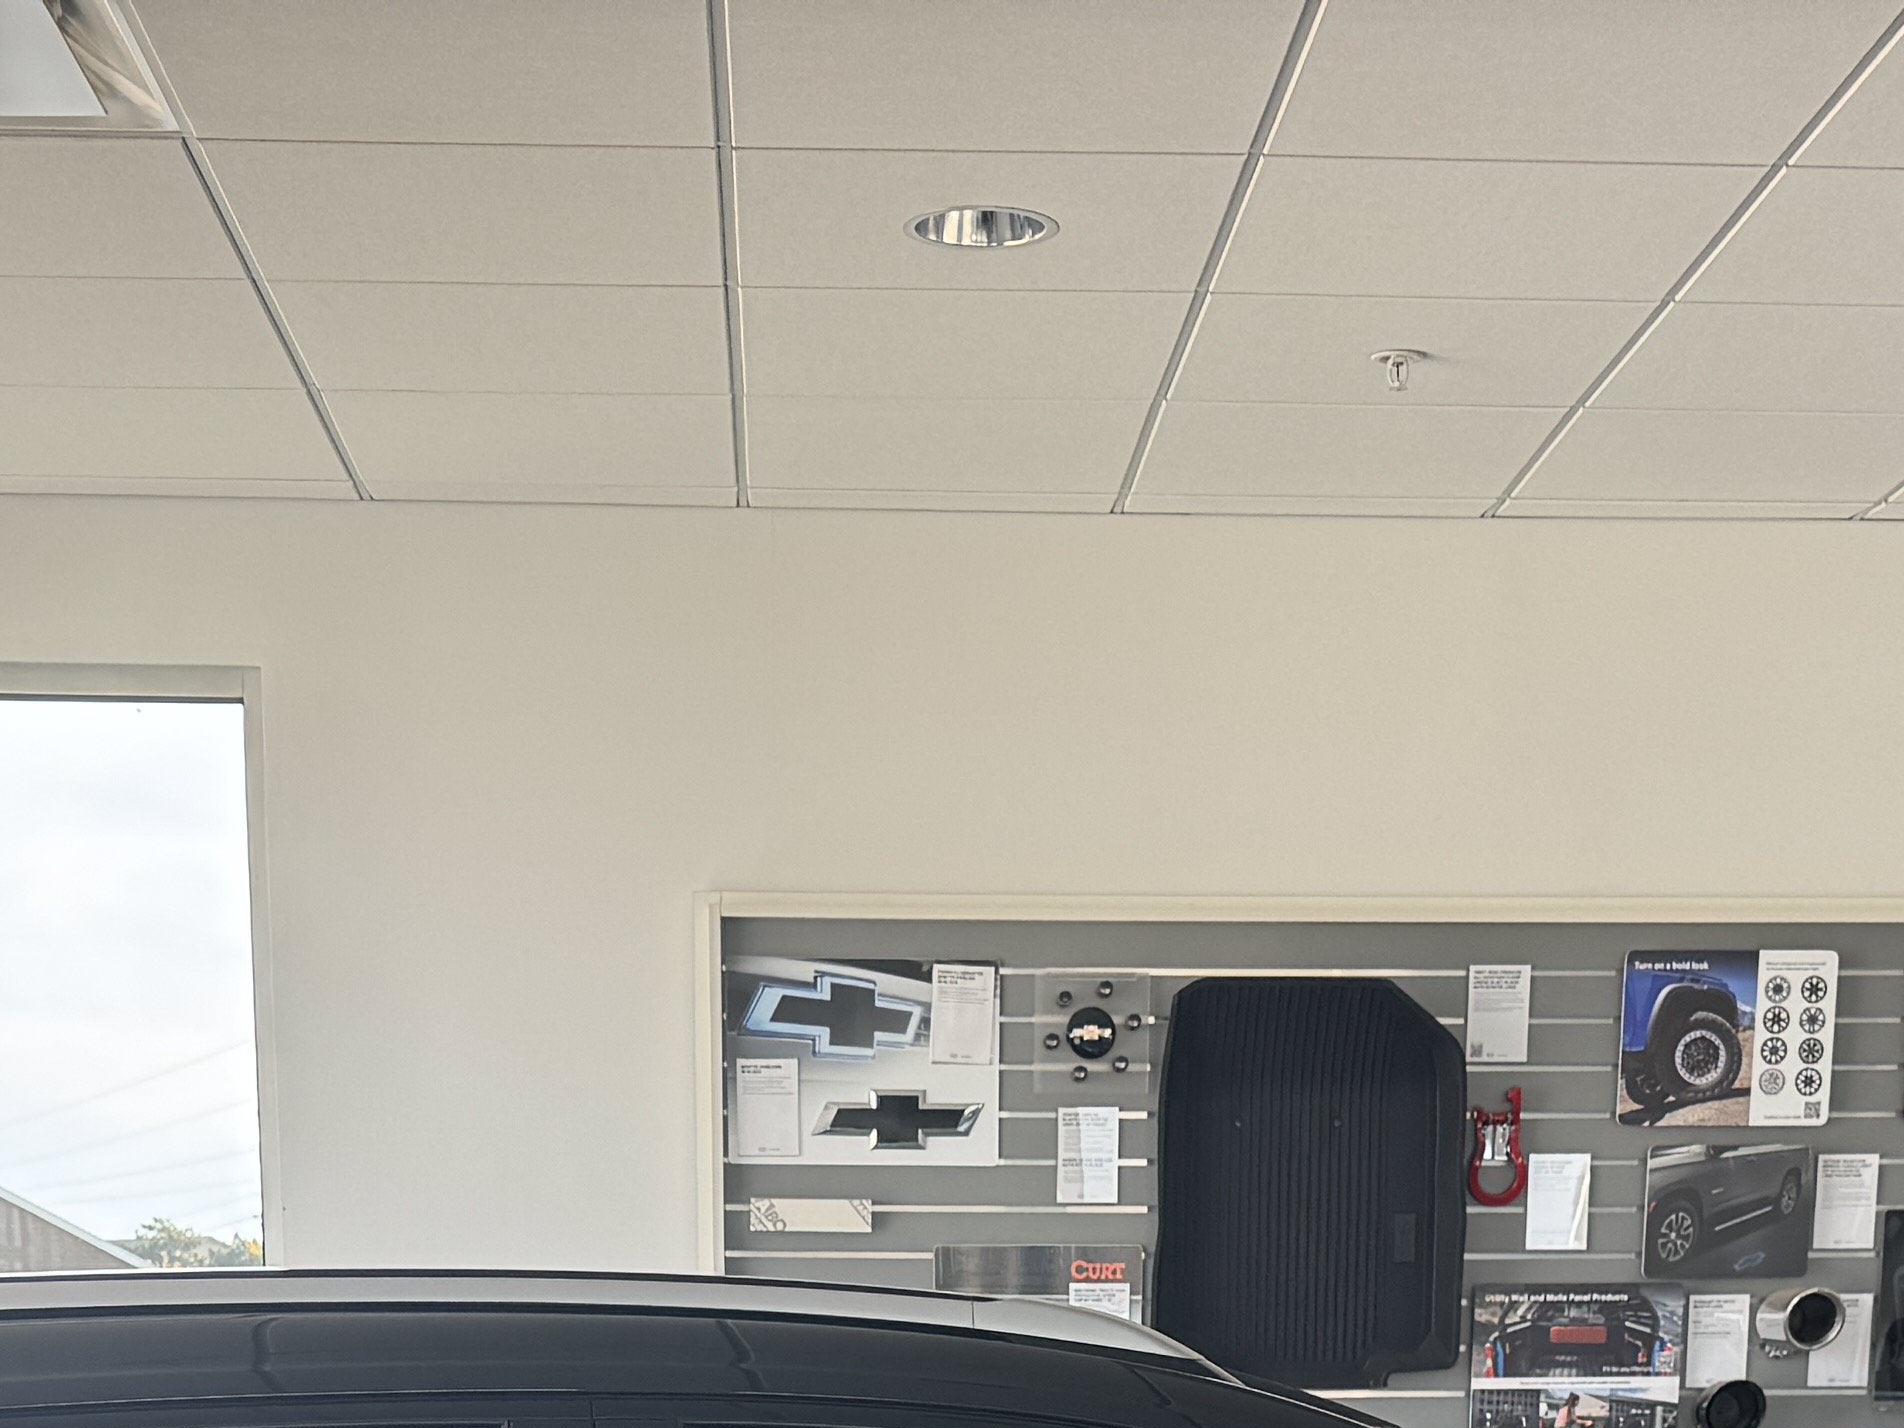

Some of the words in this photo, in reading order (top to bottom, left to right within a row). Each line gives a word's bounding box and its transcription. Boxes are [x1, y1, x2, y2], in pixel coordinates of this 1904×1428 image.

[1634, 961, 1653, 971] Turn
[1654, 962, 1665, 971] on
[1672, 961, 1691, 971] bold
[1692, 961, 1710, 971] look
[1070, 1259, 1126, 1280] CURT
